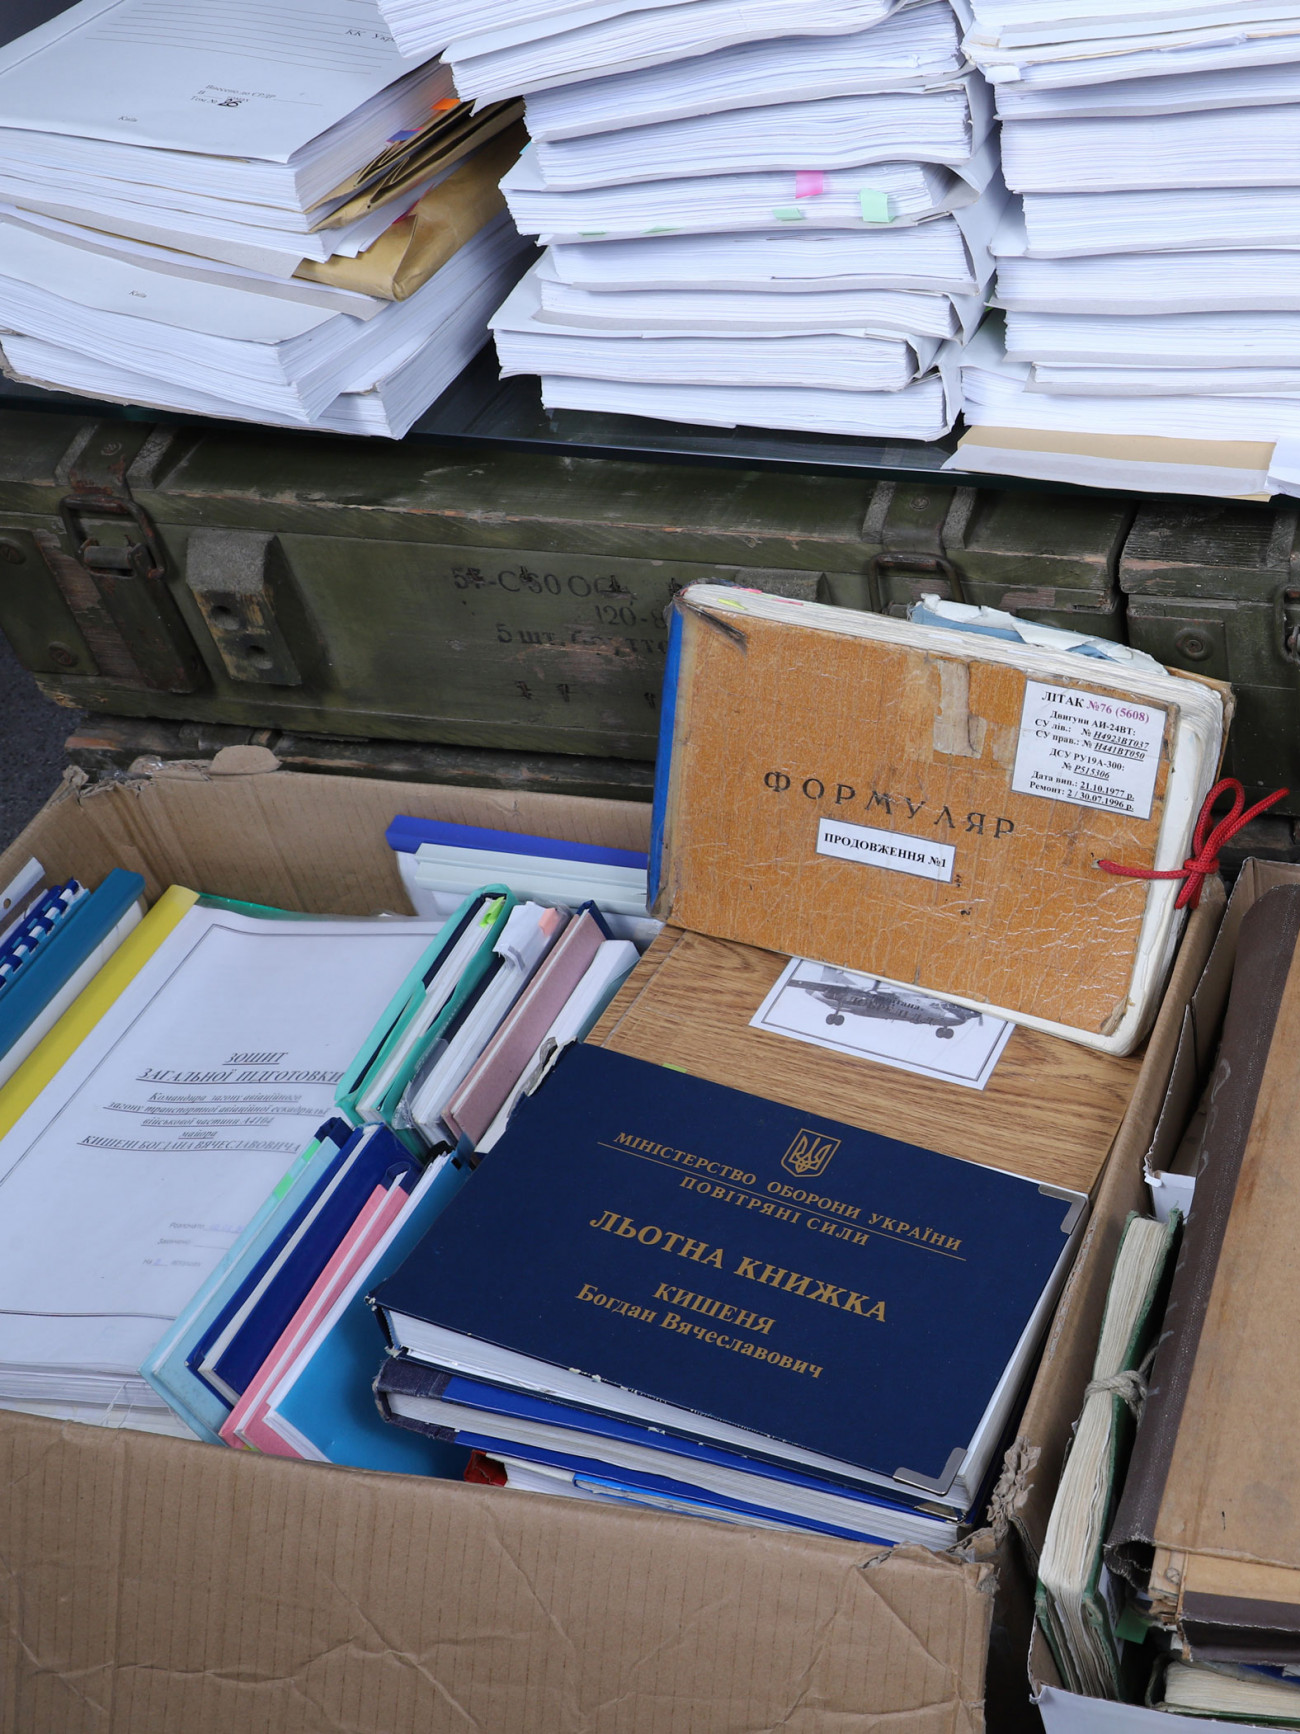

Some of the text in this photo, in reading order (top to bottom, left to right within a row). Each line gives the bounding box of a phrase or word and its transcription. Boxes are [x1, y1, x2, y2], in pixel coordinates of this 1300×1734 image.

[1042, 691, 1150, 724] ЛІТАК №76 (5608)
[1050, 710, 1136, 736] Двигуни АИ-24ВТ:
[1034, 718, 1050, 729] СУ
[1035, 729, 1051, 740] СУ
[1049, 748, 1126, 772] ДСУ РУ19А-300:
[1029, 781, 1066, 796] Ремонт:
[1079, 791, 1124, 810] 30.07.1996
[1031, 770, 1053, 783] Дата
[1080, 781, 1125, 798] 21.10.1977
[764, 771, 1015, 838] ФОРМУЛЯР
[824, 832, 947, 868] ПРОДОВЖЕННЯ №1
[226, 1052, 290, 1064] ЗОШИТ
[139, 1067, 345, 1084] ЗАГАЛЬНОЇ ПІДГОТОВКИ
[613, 1131, 962, 1252] МІНІСТЕРСТВО ОБОРОНИ УКРАЇНИ
[679, 1175, 871, 1247] ПОВІТРЯНІ СИЛИ
[589, 1210, 888, 1323] ЛЬОТНА КНИЖКА
[653, 1282, 777, 1336] КИШЕНЯ
[575, 1283, 824, 1380] Богдан Вячеславович
